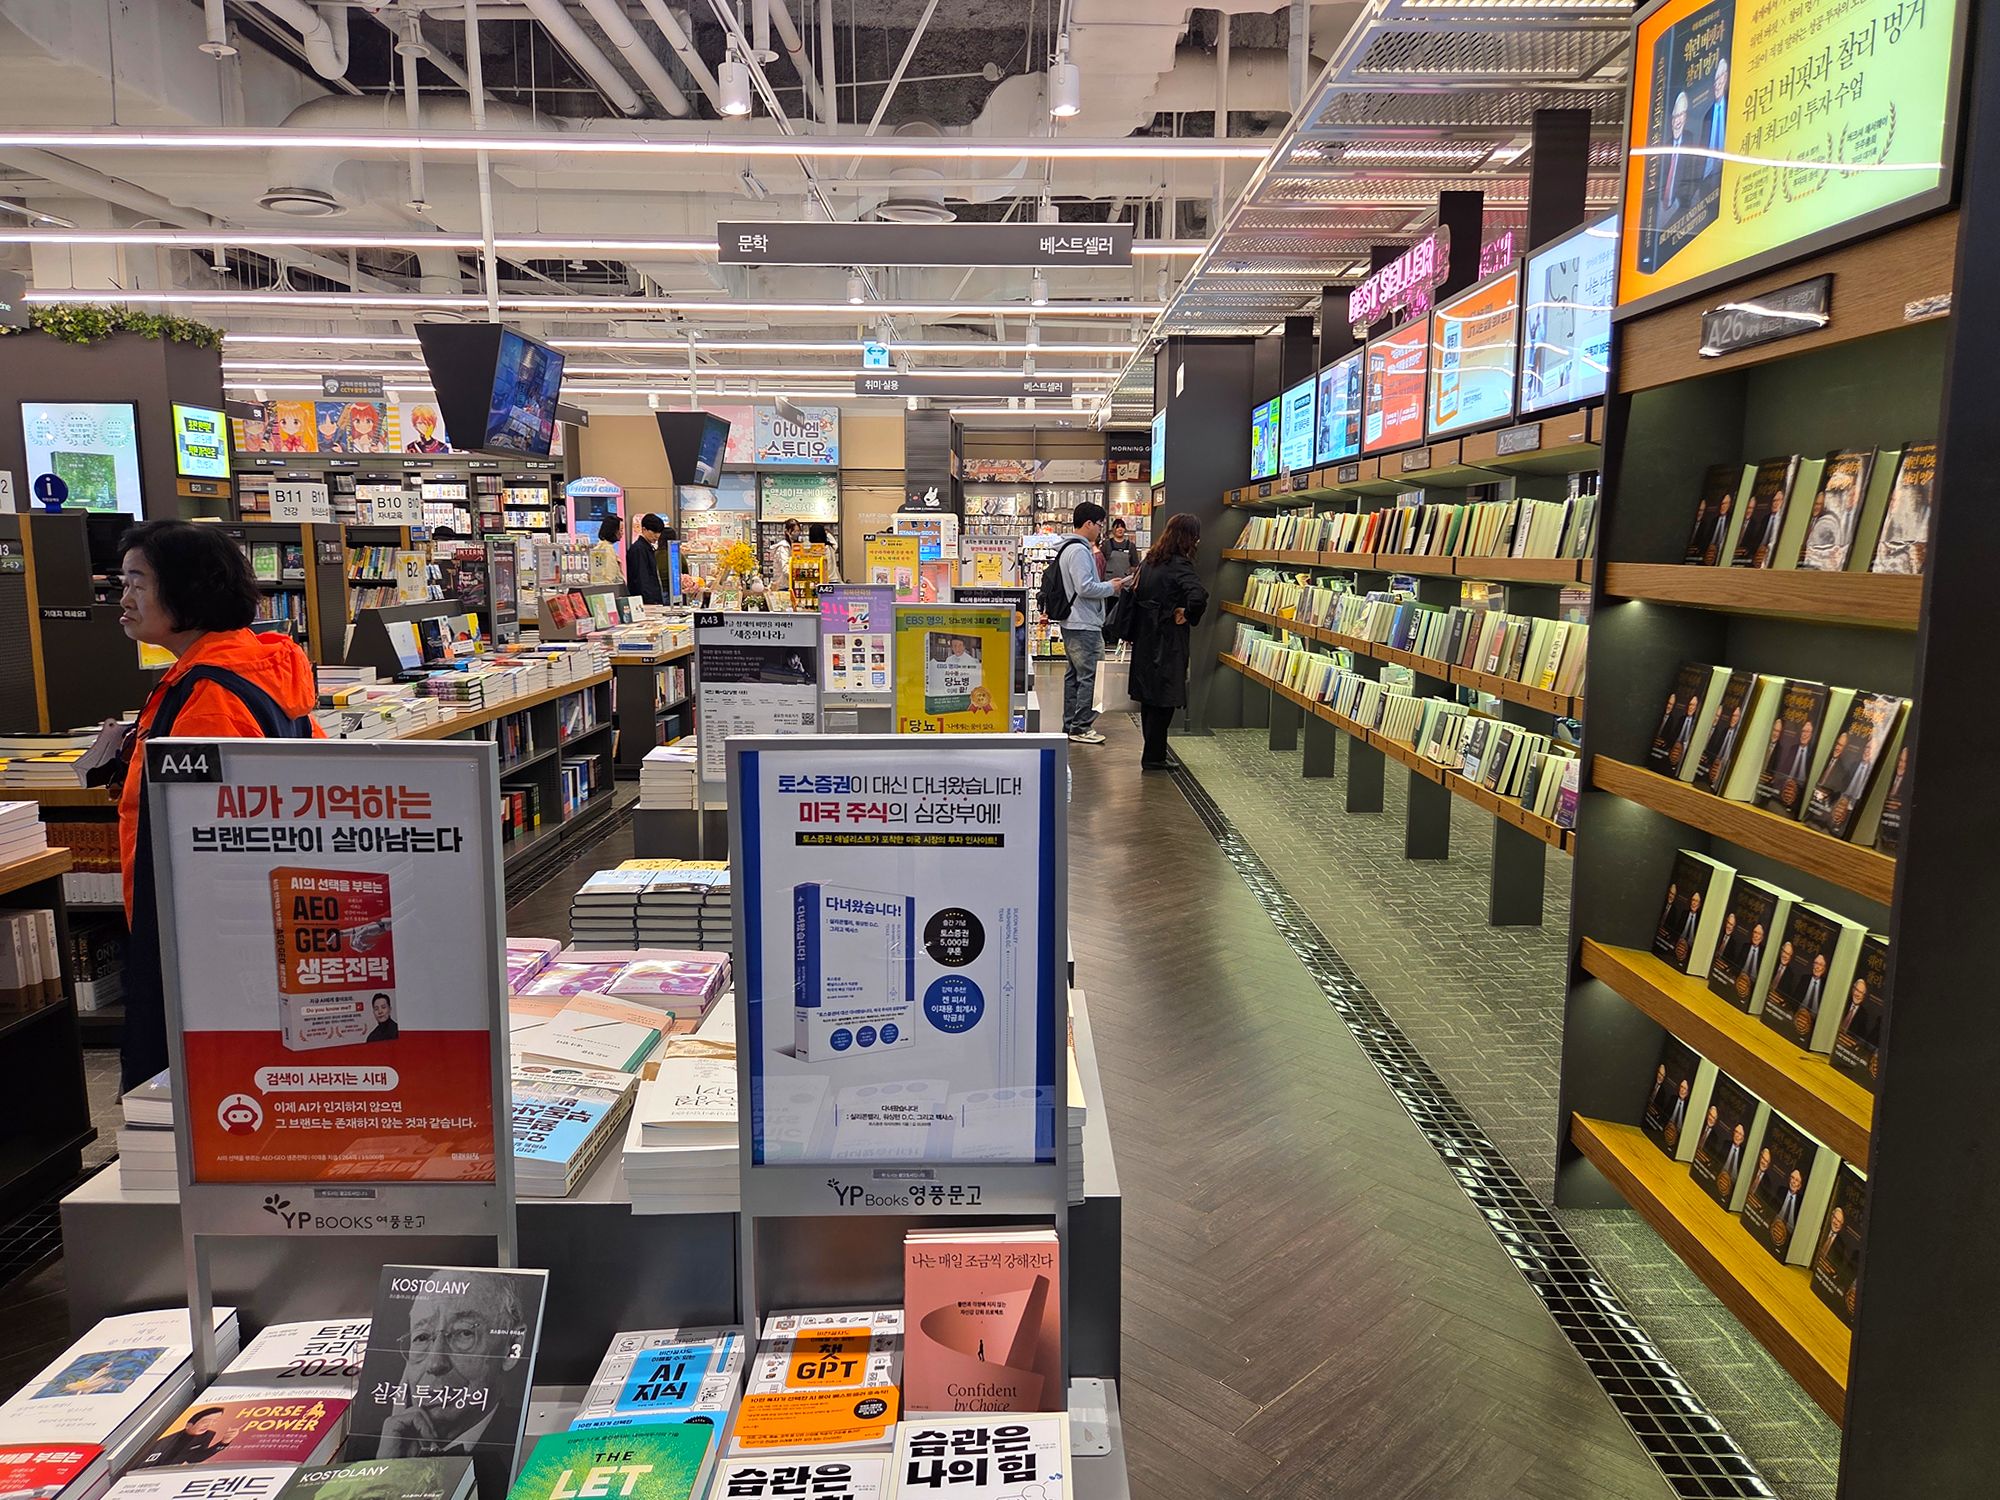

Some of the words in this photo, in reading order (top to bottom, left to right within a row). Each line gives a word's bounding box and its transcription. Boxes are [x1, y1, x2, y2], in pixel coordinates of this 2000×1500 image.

[1742, 79, 1774, 122] 워런
[1779, 46, 1833, 102] 버핏과
[1837, 19, 1876, 72] 찰리
[1883, 0, 1926, 45] 멍거
[1764, 104, 1801, 143] 최고의
[1804, 89, 1832, 124] 투자
[1835, 72, 1864, 109] 수업
[738, 234, 769, 253] 문학
[1040, 236, 1113, 255] 베스트셀러
[1349, 273, 1380, 323] BEST
[1380, 235, 1435, 304] SELLER
[1708, 312, 1744, 348] A26
[1024, 382, 1063, 393] 베스트셀러
[773, 421, 820, 438] 아이엠
[767, 440, 828, 457] 스튜디오
[275, 490, 302, 503] B11
[312, 490, 325, 504] B11
[377, 497, 402, 509] B10
[283, 507, 298, 516] 건강
[378, 512, 403, 520] 자녀교육
[407, 561, 418, 577] B2
[700, 615, 718, 625] A43
[906, 616, 924, 625] EBS
[927, 616, 946, 626] 명의,
[944, 677, 970, 687] 당뇨병
[161, 754, 209, 774] A44
[778, 775, 868, 795] 토스증권이
[872, 776, 907, 795] 대신
[912, 776, 1022, 795] 다녀왔습니다!
[217, 785, 283, 819] AI가
[292, 785, 432, 820] 기억하는
[800, 802, 839, 823] 미국
[846, 801, 907, 823] 주식의
[914, 802, 1001, 824] 심장부에!
[192, 827, 323, 852] 브랜드만이
[331, 827, 463, 852] 살아남는다
[802, 835, 833, 844] 토스증권
[834, 835, 881, 844] 애널리스트가
[881, 835, 904, 844] 포착한
[906, 835, 921, 844] 미국
[923, 835, 946, 844] 시장의
[948, 835, 963, 844] 투자
[966, 836, 998, 845] 인사이트!
[291, 877, 316, 891] AI의
[318, 878, 350, 892] 선택을
[352, 880, 383, 894] 부르는
[293, 896, 339, 921] AEO
[826, 897, 902, 917] 다녀왔습니다!
[295, 928, 341, 953] GEO
[940, 930, 969, 938] 토스증권
[940, 939, 969, 947] 5,000원
[947, 947, 962, 955] 쿠폰
[297, 957, 389, 985] 생존전략
[942, 996, 950, 1004] 켄
[951, 996, 966, 1004] 피셔
[955, 1005, 977, 1013] 회계사
[266, 1073, 304, 1086] 검색이
[308, 1072, 358, 1086] 사라지는
[362, 1072, 388, 1086] 시대
[274, 1101, 297, 1113] 이제
[298, 1102, 322, 1113] AI가
[323, 1101, 368, 1113] 인지하지
[370, 1101, 403, 1113] 않으면
[275, 1118, 287, 1129] 그
[289, 1118, 333, 1129] 브랜드는
[335, 1118, 380, 1129] 존재하지
[382, 1118, 403, 1129] 않는
[405, 1118, 427, 1129] 것과
[429, 1117, 478, 1129] 같습니다.
[883, 1113, 900, 1121] 워싱턴
[901, 1113, 915, 1121] D.C.
[916, 1113, 934, 1121] 그리고
[935, 1113, 954, 1121] 텍사스
[834, 1185, 863, 1206] YP
[865, 1193, 909, 1206] Books
[909, 1185, 982, 1206] 영풍문고
[281, 1212, 311, 1229] YP
[316, 1216, 373, 1229] BOOKS
[912, 1253, 936, 1268] 나는
[939, 1253, 963, 1268] 매일
[965, 1253, 1001, 1268] 조금씩
[1004, 1253, 1054, 1269] 강해진다
[391, 1278, 471, 1295] KOSTOLANY
[510, 1344, 522, 1359] 3
[818, 1343, 843, 1360] 챗
[277, 1358, 363, 1378] 2026
[648, 1363, 686, 1382] AI
[797, 1361, 858, 1380] GPT
[371, 1382, 408, 1405] 실전
[412, 1385, 489, 1411] 투자강의
[632, 1383, 688, 1401] 지식
[948, 1383, 1017, 1397] Confident
[236, 1406, 304, 1418] HORSE
[954, 1398, 968, 1411] by
[970, 1398, 1010, 1411] Choice
[242, 1419, 319, 1432] POWER
[909, 1425, 1032, 1457] 습관은
[33, 1452, 84, 1463] 부르는
[595, 1451, 635, 1463] THE
[300, 1465, 389, 1483] KOSTOLANY
[907, 1459, 989, 1489] 나의
[997, 1453, 1038, 1486] 힘
[172, 1474, 276, 1500] 트렌드
[550, 1464, 654, 1500] LET
[727, 1463, 854, 1498] 습관은
